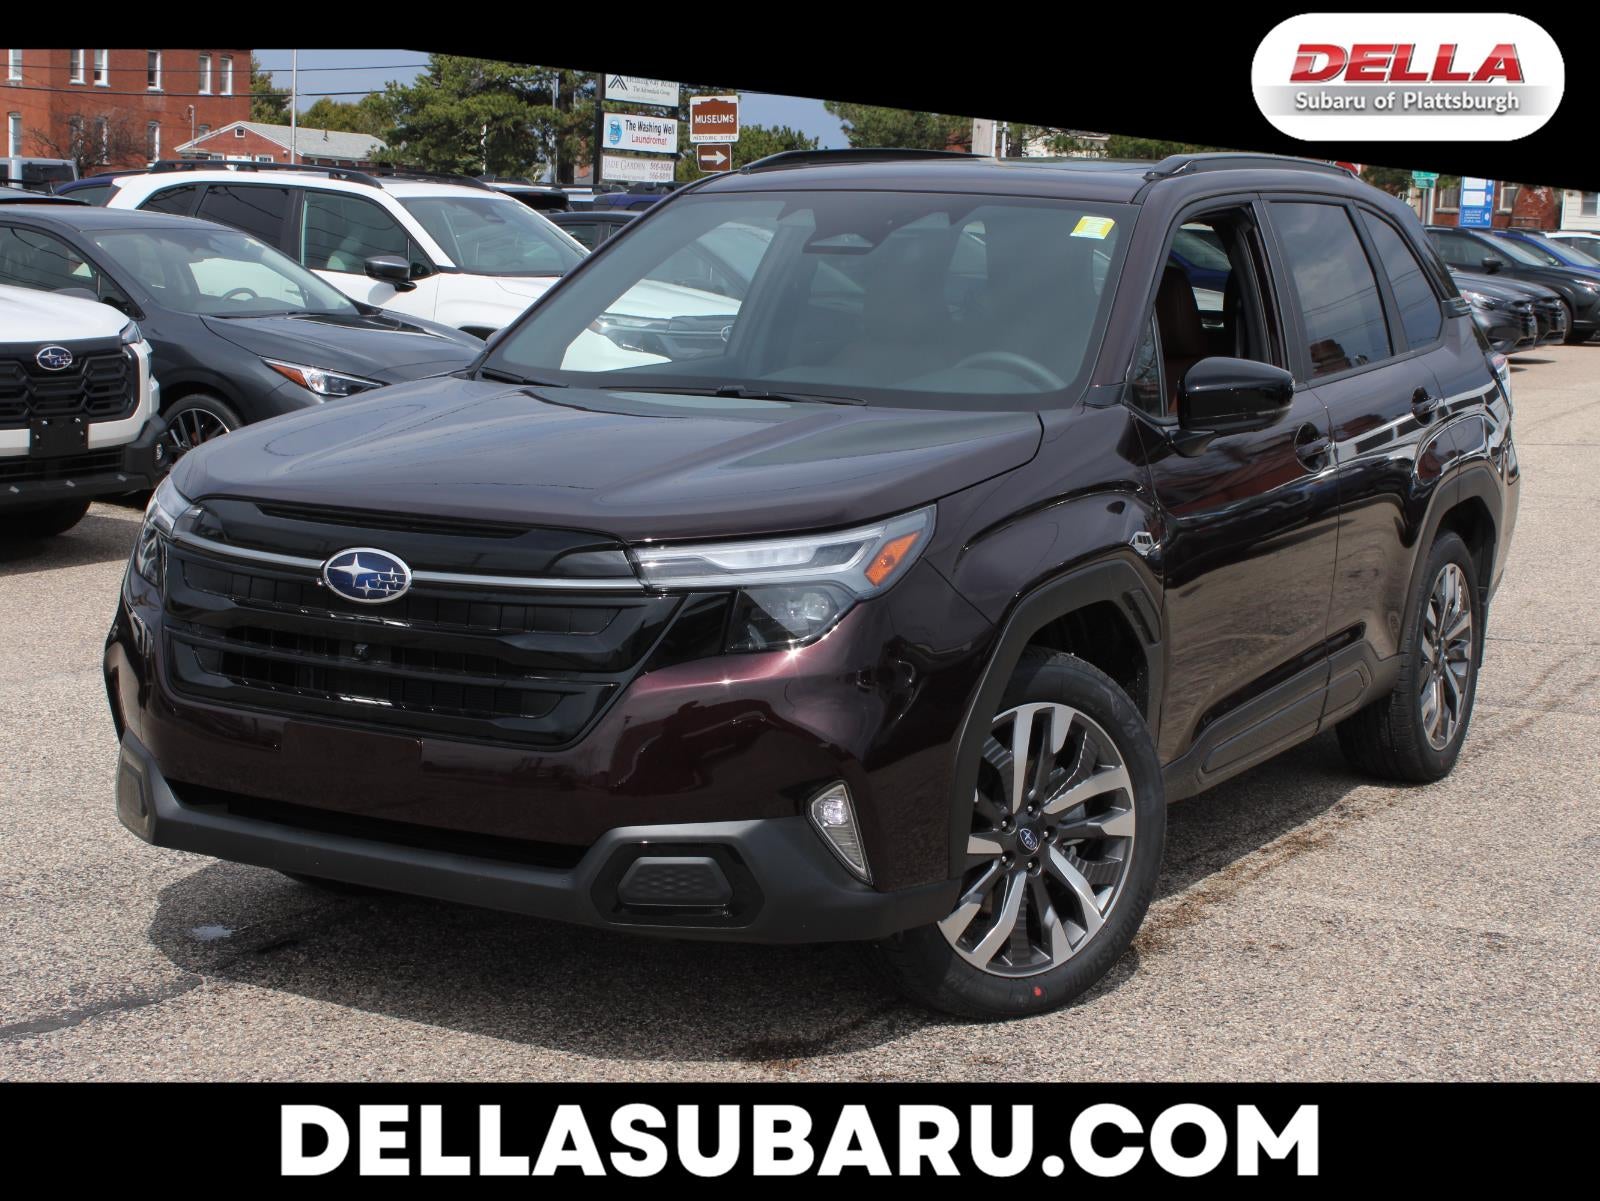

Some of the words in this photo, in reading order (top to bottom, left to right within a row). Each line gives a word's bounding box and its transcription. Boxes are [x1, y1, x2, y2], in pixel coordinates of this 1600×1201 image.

[694, 113, 735, 124] MUSEUMS
[625, 119, 636, 132] The
[637, 121, 662, 136] Washing
[662, 123, 675, 135] Well
[631, 134, 668, 145] Laundromat
